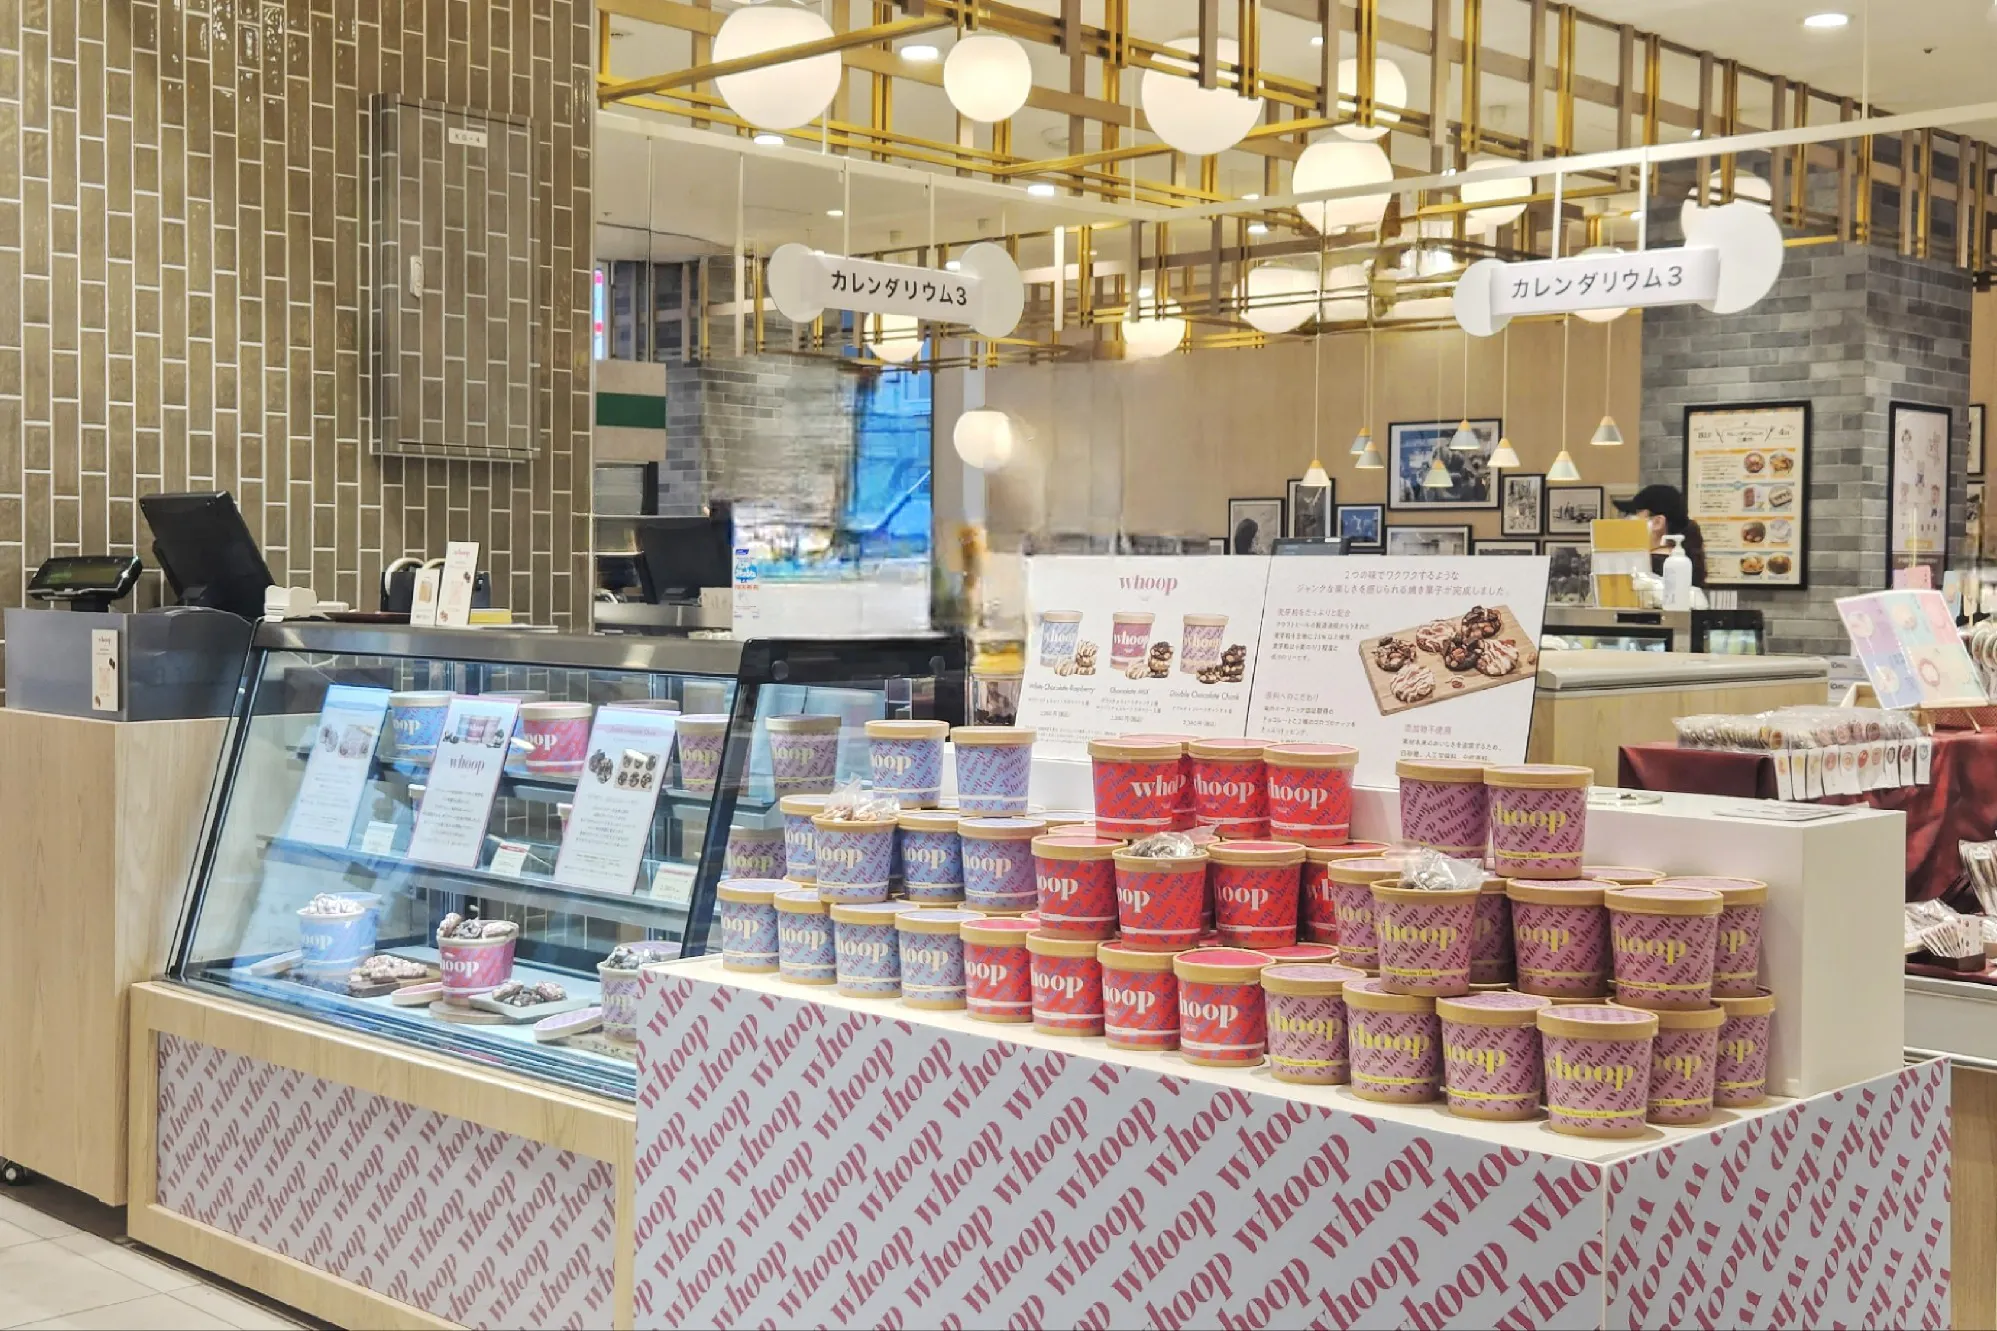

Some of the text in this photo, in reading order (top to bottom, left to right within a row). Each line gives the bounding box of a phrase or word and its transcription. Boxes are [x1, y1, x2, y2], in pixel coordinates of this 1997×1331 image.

[831, 270, 967, 306] カレンダリウム3
[1511, 265, 1683, 299] カレンダリウム3
[1118, 574, 1179, 597] whoop
[449, 754, 486, 776] whoop
[638, 1014, 710, 1110] whoop
[685, 1013, 759, 1111] whoop
[750, 1002, 828, 1088] whoop
[812, 1037, 896, 1141] whoop
[866, 1037, 953, 1142] whoop
[677, 1089, 751, 1185] whoop
[725, 1090, 802, 1187] whoop
[858, 1119, 944, 1223] whoop
[913, 1120, 1005, 1226] whoop
[992, 1096, 1089, 1206] whoop
[1055, 1097, 1158, 1209] whoop
[1144, 1087, 1254, 1187] whoop
[653, 1187, 726, 1279] whoop
[736, 1140, 813, 1238] whoop
[787, 1142, 868, 1241] whoop
[1232, 1133, 1352, 1255] whoop
[1310, 1136, 1436, 1259] whoop
[663, 1236, 737, 1329] whoop
[710, 1240, 788, 1331] whoop
[776, 1221, 859, 1319] whoop
[830, 1225, 915, 1325] whoop
[904, 1204, 994, 1309] whoop
[962, 1208, 1057, 1314] whoop
[1044, 1186, 1147, 1296] whoop
[1111, 1189, 1218, 1303] whoop
